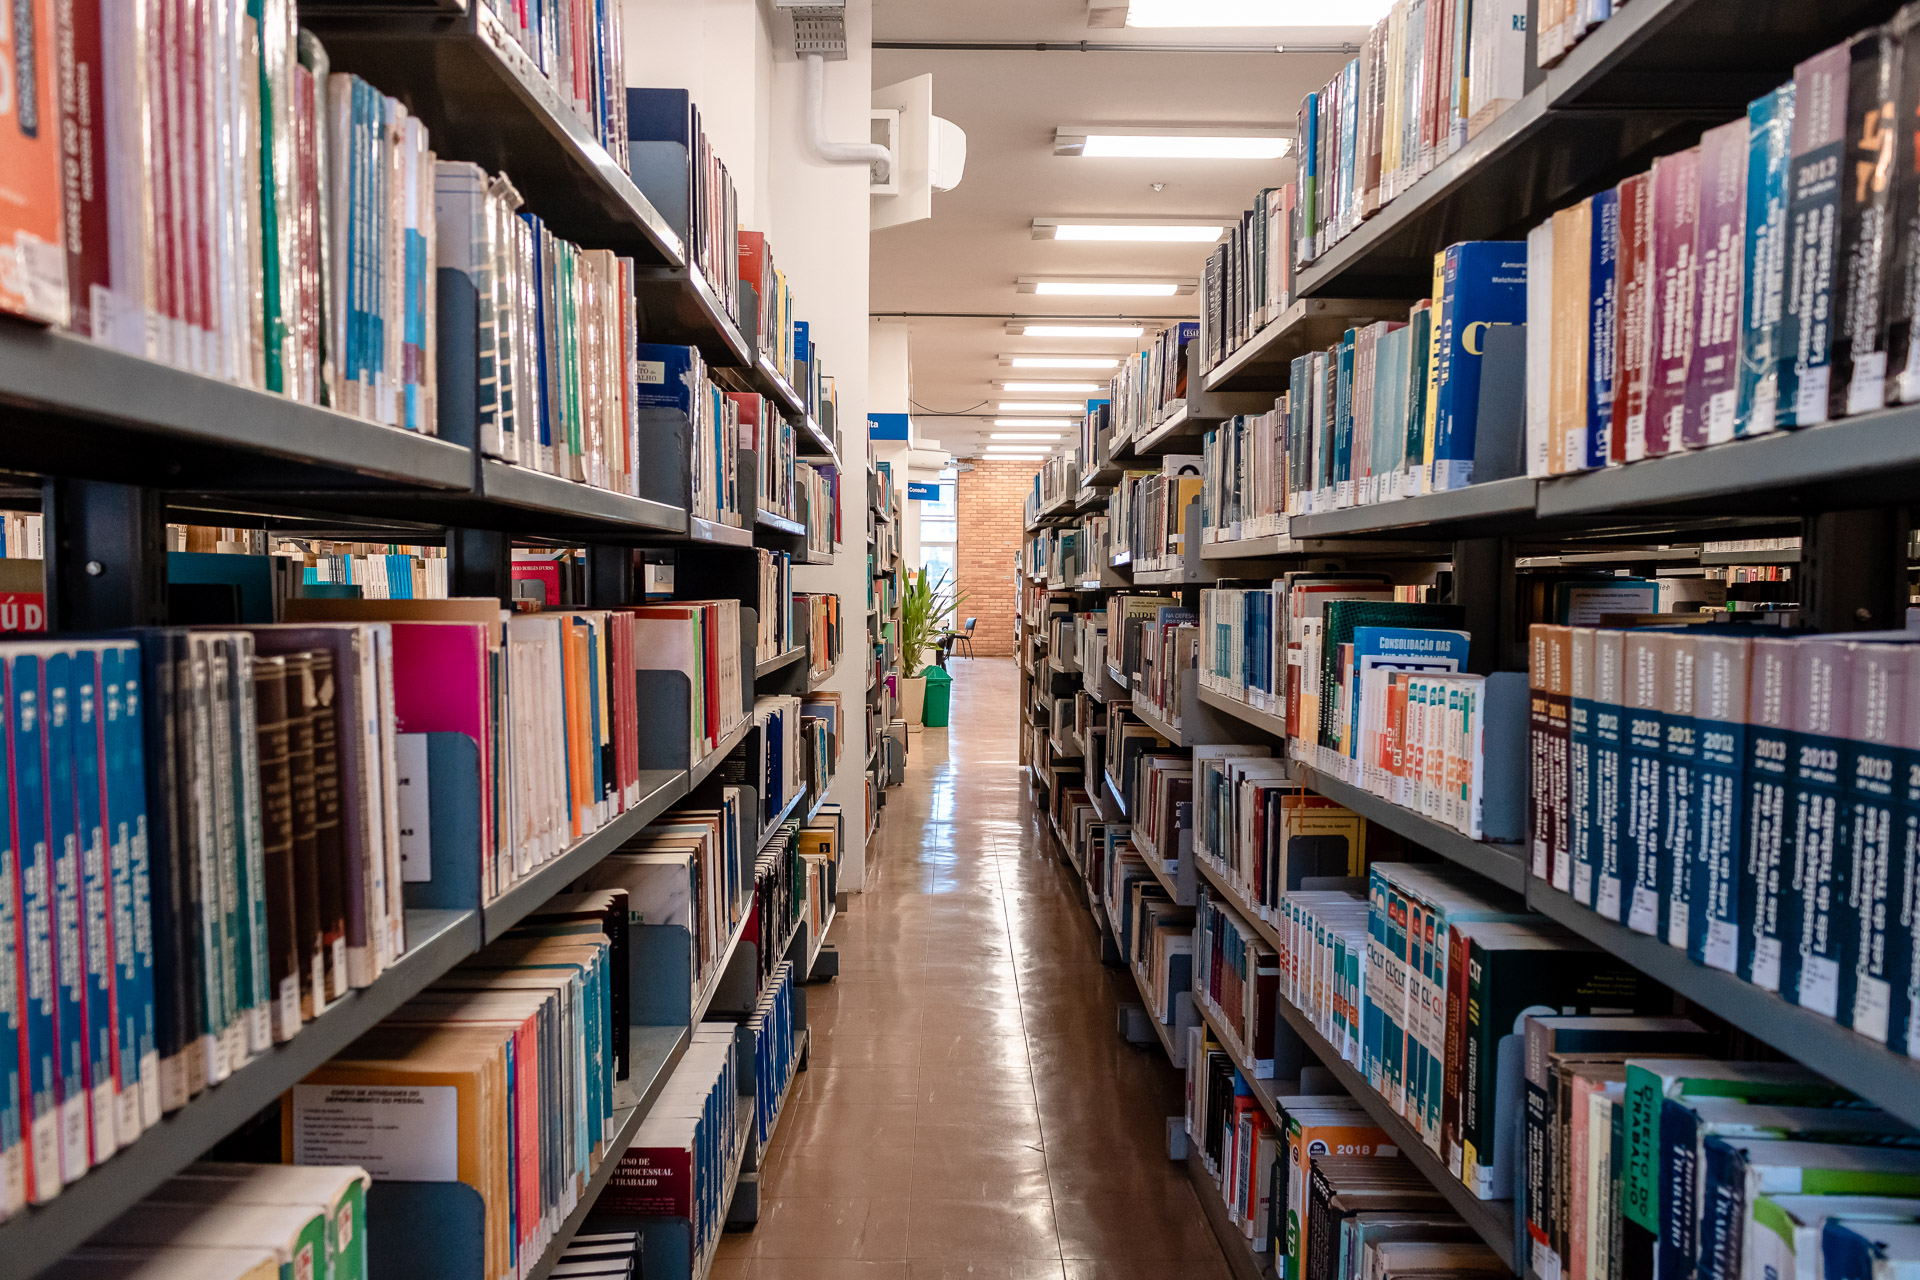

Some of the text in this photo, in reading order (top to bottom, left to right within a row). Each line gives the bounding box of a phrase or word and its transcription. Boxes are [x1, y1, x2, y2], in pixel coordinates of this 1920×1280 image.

[80, 128, 93, 201] HENRIQUE
[1798, 155, 1839, 188] 2013
[62, 118, 82, 255] DIREITO DO
[1804, 208, 1821, 246] das
[1814, 203, 1836, 294] Trabalho
[1788, 225, 1805, 316] Comentários
[1794, 247, 1818, 377] Consolidação
[1813, 294, 1830, 321] do
[1183, 329, 1200, 337] CESAR
[1809, 322, 1827, 365] Leis
[908, 486, 927, 494] Consulta
[1379, 636, 1451, 652] CONSOLIDAÇÃO DAS
[1637, 645, 1647, 706] VALENTIN
[1645, 651, 1655, 708] CARRION
[1673, 649, 1685, 713] VALENTIN
[1683, 655, 1694, 714] CARRION
[1597, 712, 1619, 731] 2012
[1631, 719, 1661, 738] 2012
[1386, 727, 1394, 755] CLT
[1393, 748, 1403, 767] CLT
[1702, 731, 1734, 753] 2012
[1754, 738, 1787, 762] 2013
[1799, 746, 1838, 771] 2013
[1405, 743, 1415, 778] CLT
[1415, 746, 1424, 782] CLT
[1638, 758, 1650, 788] das
[1855, 754, 1894, 782] 2013
[1676, 767, 1689, 797] das
[1711, 775, 1725, 807] das
[1760, 784, 1774, 818] das
[1807, 794, 1823, 831] das
[1636, 789, 1650, 889] Consolidação
[1646, 760, 1661, 888] Leis do Trabalho
[1769, 786, 1785, 867] Trabalho
[1817, 797, 1836, 883] Trabalho
[1863, 806, 1878, 844] das
[1670, 799, 1689, 902] Consolidação
[1705, 809, 1723, 921] Consolidação
[1716, 777, 1734, 918] Leis do Trabalho
[1873, 809, 1891, 900] Trabalho
[1753, 819, 1772, 938] Consolidação
[1767, 869, 1780, 894] do
[1799, 832, 1821, 956] Consolidação
[1764, 896, 1778, 935] Leis
[1816, 885, 1831, 912] do
[1855, 846, 1876, 977] Consolidação
[1871, 903, 1887, 931] do
[1812, 914, 1829, 954] Leis
[1373, 950, 1385, 969] CLT
[1469, 957, 1482, 985] CLT
[1869, 933, 1885, 976] Leis
[1394, 968, 1406, 988] CLT
[1409, 977, 1420, 998] CLT
[621, 1157, 650, 1166] RSO DE
[1336, 1143, 1371, 1155] 2018
[1629, 1088, 1643, 1206] TRABALHO
[1638, 1085, 1654, 1218] DIREITO DO
[615, 1178, 658, 1187] TRABALHO
[621, 1168, 673, 1176] PROCESSUAL
[1671, 1144, 1685, 1248] TRABALHO
[1288, 1217, 1296, 1258] CLT
